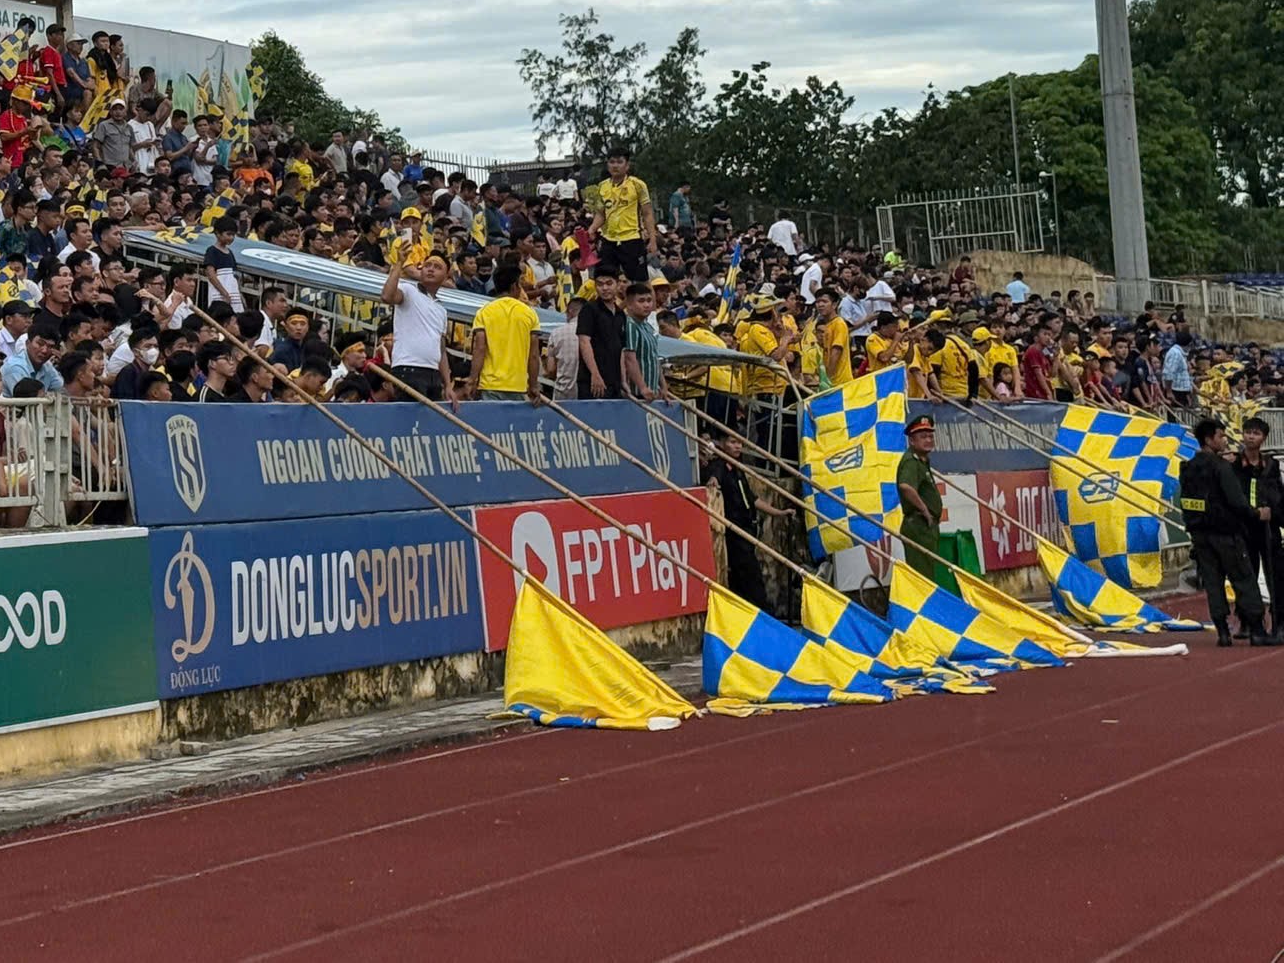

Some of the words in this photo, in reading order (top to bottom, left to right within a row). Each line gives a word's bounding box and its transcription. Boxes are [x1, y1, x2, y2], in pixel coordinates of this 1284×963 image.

[12, 12, 45, 33] FD
[256, 439, 327, 484] NGOAN
[390, 421, 435, 477] CHẤT
[550, 423, 588, 468] SÔNG
[590, 428, 620, 466] LAM
[231, 540, 468, 646] DONGLUCSPORT.VN
[562, 526, 621, 605] FPT
[626, 522, 689, 607] Play
[170, 665, 200, 692] ĐỘNG
[201, 664, 221, 687] LỰC
